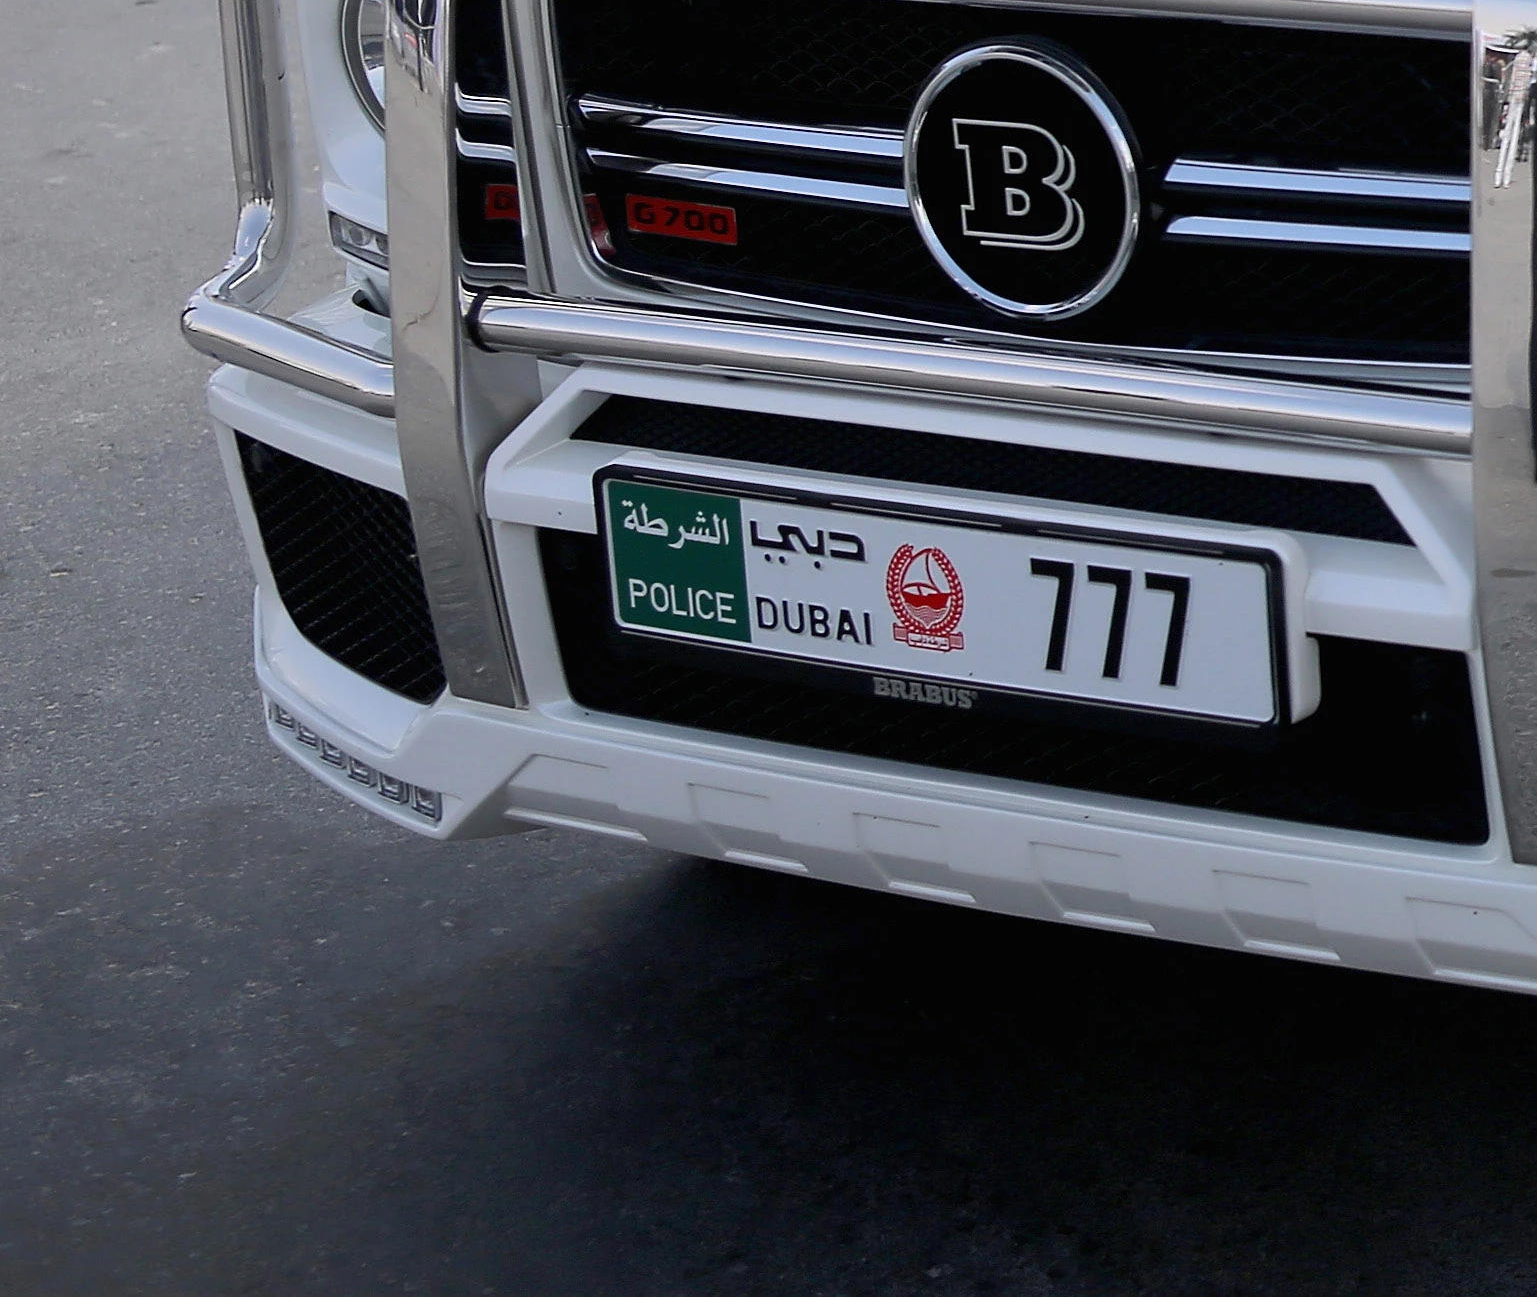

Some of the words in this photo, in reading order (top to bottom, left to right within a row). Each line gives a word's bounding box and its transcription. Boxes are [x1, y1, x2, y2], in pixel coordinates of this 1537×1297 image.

[952, 117, 1085, 251] B
[634, 203, 656, 226] G
[663, 205, 729, 235] 700
[622, 500, 729, 549] الشرطة
[749, 519, 868, 570] دبي
[628, 578, 737, 624] POLICE
[756, 596, 873, 646] DUBAI
[1029, 557, 1191, 686] 777
